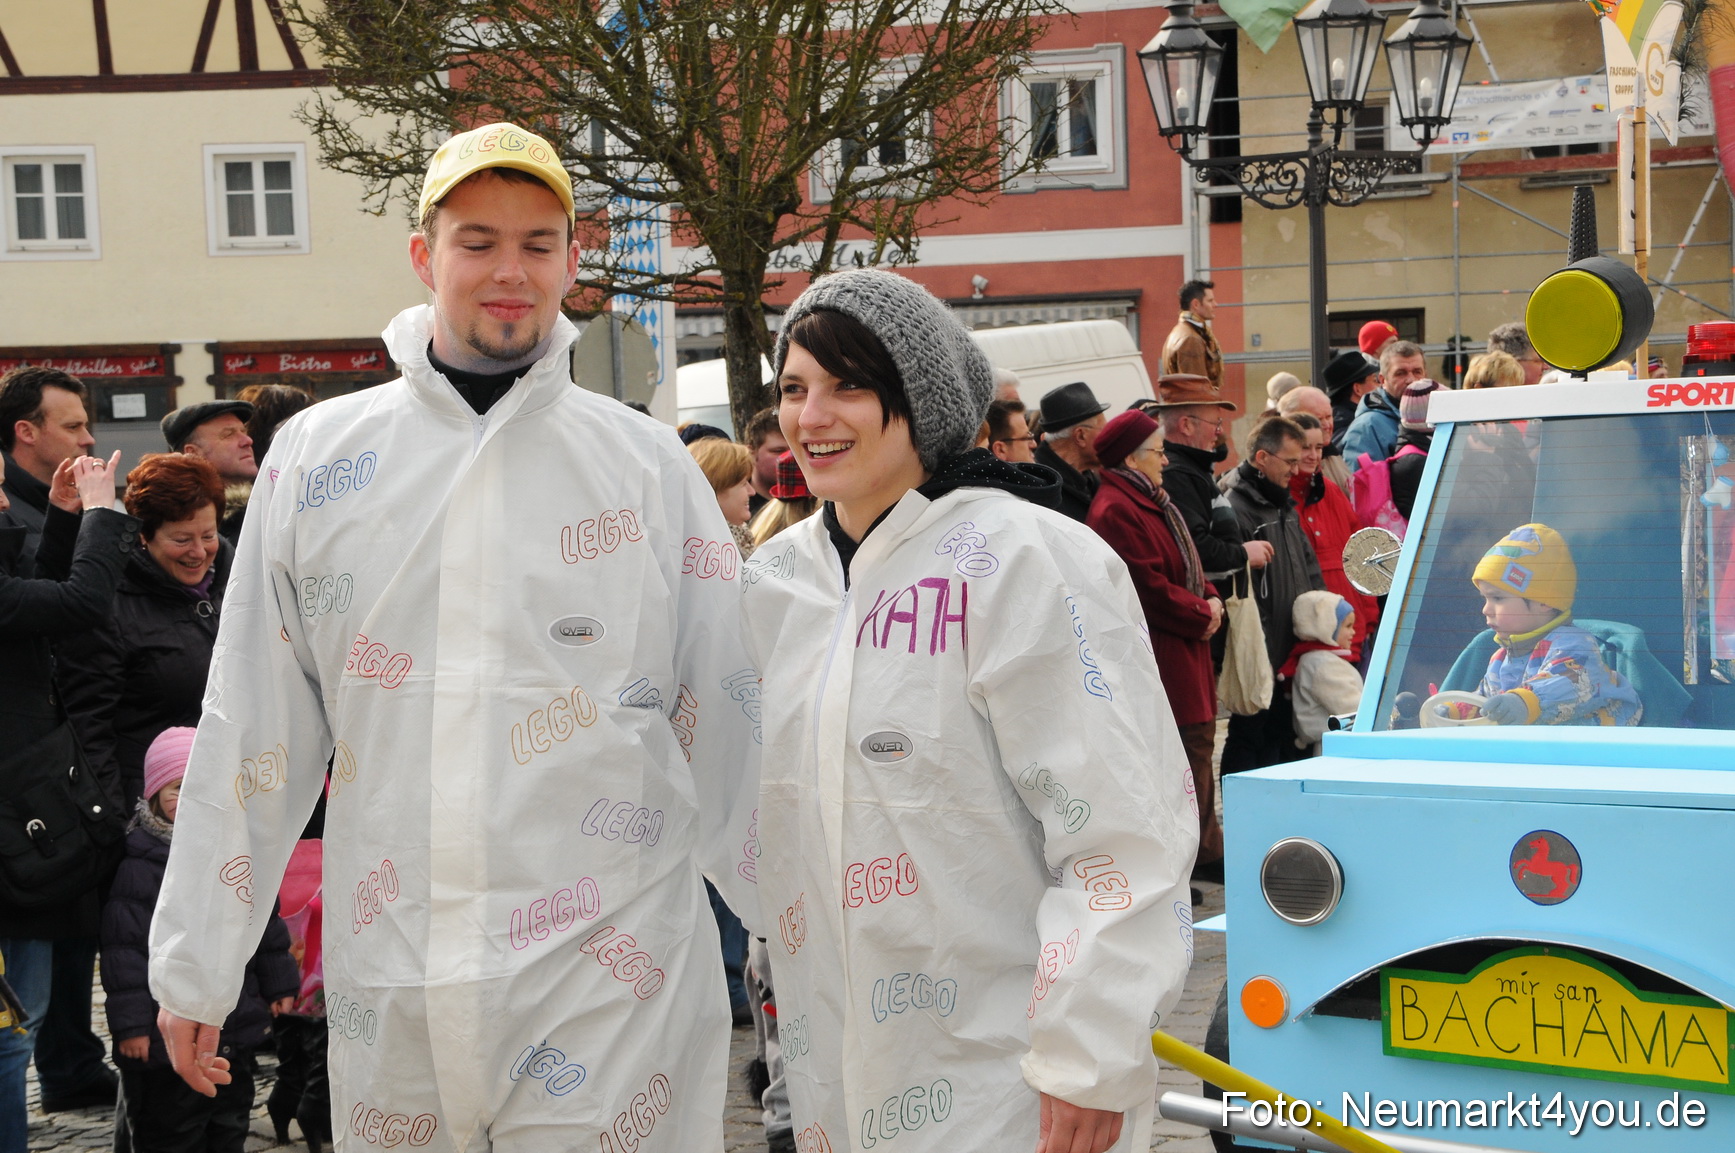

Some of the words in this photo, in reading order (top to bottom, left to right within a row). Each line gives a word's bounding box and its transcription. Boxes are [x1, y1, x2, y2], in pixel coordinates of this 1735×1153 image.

[1609, 66, 1637, 78] FASCHINGS
[1614, 84, 1634, 96] GRUPPE
[459, 127, 550, 164] LEGO
[279, 353, 332, 372] Bistro
[1646, 381, 1735, 408] SPORT
[560, 508, 643, 565] LEGO
[295, 572, 354, 618] EGO
[511, 685, 598, 765] LEGO
[580, 797, 664, 847] LEGO
[1017, 761, 1091, 835] LEGO
[351, 859, 400, 935] LEGO
[842, 852, 919, 910] EGO
[509, 876, 600, 951] LEGO
[579, 925, 666, 1001] LEGO
[1496, 970, 1538, 997] mir
[1554, 982, 1603, 1004] san
[871, 972, 958, 1023] LEGO
[1400, 984, 1725, 1076] BACHAMA
[349, 1101, 438, 1149] LEGO
[861, 1078, 953, 1149] LEGO
